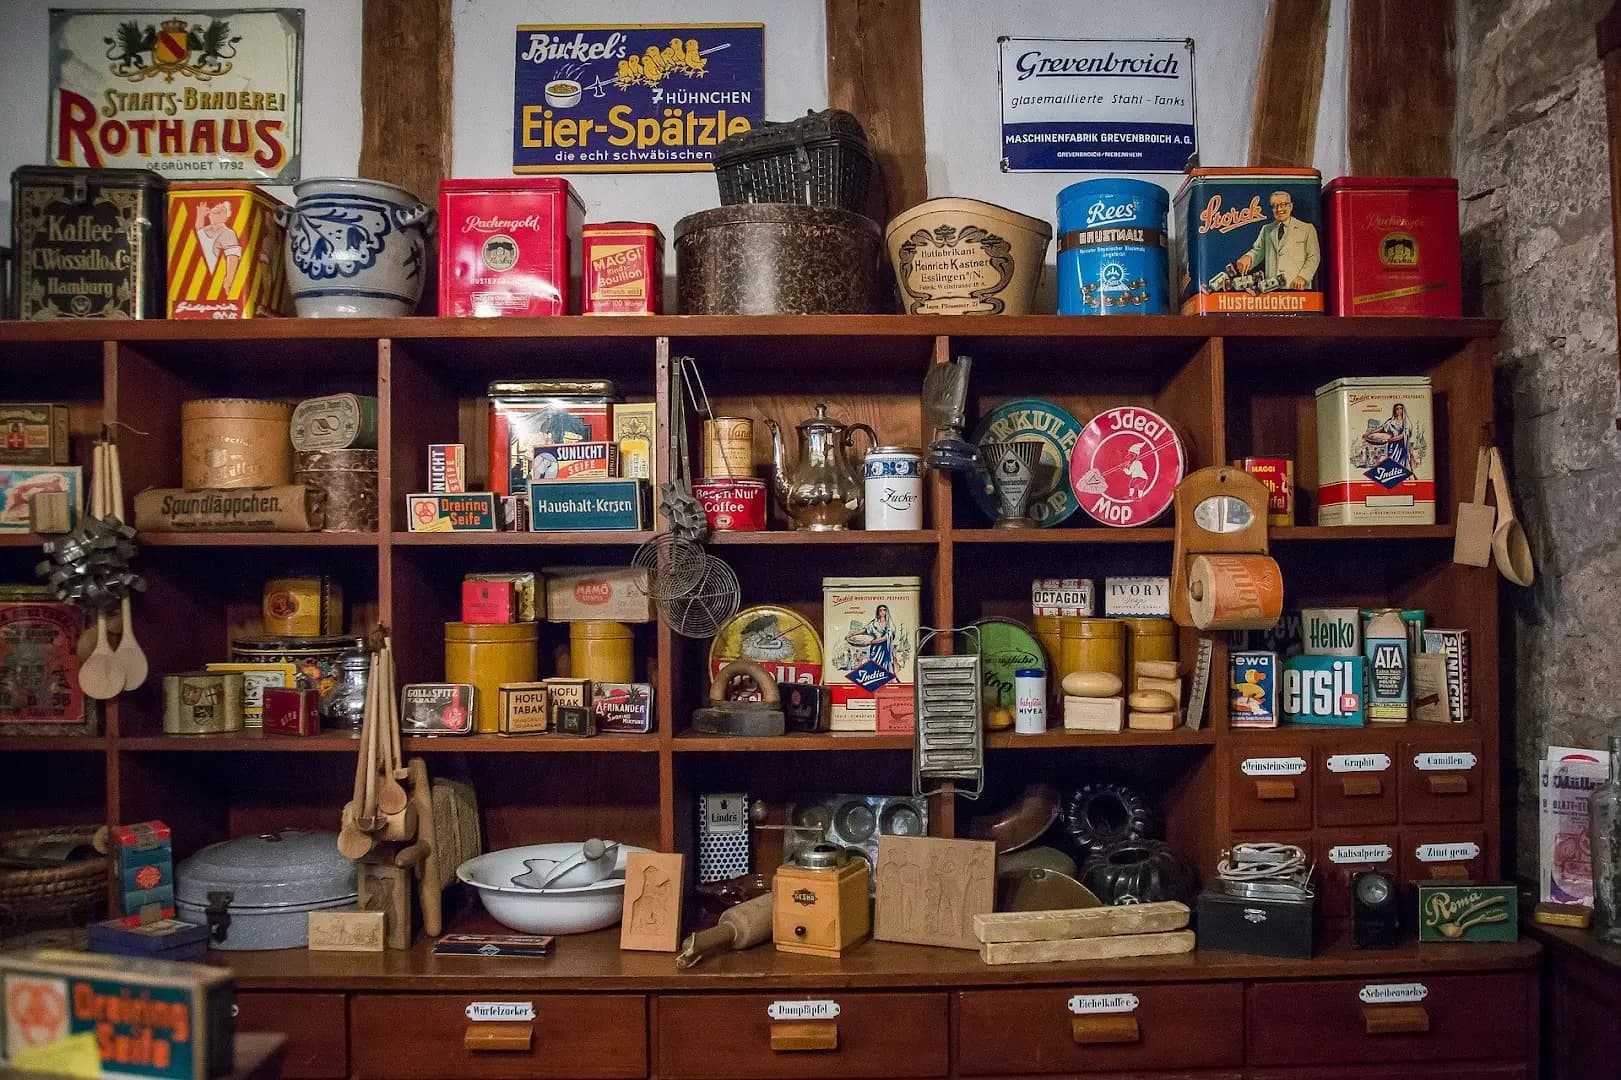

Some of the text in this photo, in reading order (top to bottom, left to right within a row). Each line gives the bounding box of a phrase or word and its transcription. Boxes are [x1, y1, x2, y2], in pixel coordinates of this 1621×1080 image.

[521, 32, 628, 64] Birkel's
[1016, 51, 1179, 81] Grevenbroich
[666, 89, 751, 104] HÜHNCHEN
[58, 88, 287, 171] ROTHAUS
[522, 105, 751, 148] Eier-Spätzle
[1006, 133, 1098, 145] MASCHINENFABRIK
[1101, 134, 1172, 144] GREVENBROICH
[555, 149, 713, 162] die echt schwäbischen
[219, 161, 245, 171] 1792
[1086, 200, 1136, 224] Rees
[1199, 194, 1268, 234] Storck
[48, 215, 114, 242] Kaffee
[461, 215, 540, 233] Rachengold
[915, 261, 949, 272] Heinrich
[921, 273, 966, 283] Esslingen
[48, 278, 113, 298] Hamburg
[1218, 294, 1307, 310] Hustendoktor
[556, 446, 603, 462] SUNLICHT
[431, 449, 446, 493] NLICHT
[567, 461, 596, 474] SEIFE
[1374, 468, 1404, 480] India
[446, 460, 460, 491] SEIFE
[160, 494, 284, 519] Spundläppchen.
[538, 498, 633, 514] Haushalt-Kerzen
[880, 487, 917, 511] Zucker
[441, 499, 488, 517] Dreiring
[704, 502, 745, 513] Coffee
[1090, 497, 1133, 524] Mop
[450, 512, 481, 526] Seife
[1111, 583, 1164, 597] IVORY
[1034, 591, 1087, 605] OCTAGON
[1310, 617, 1355, 649] Henko
[1374, 646, 1404, 669] ATA
[856, 669, 887, 684] India
[1444, 634, 1461, 720] SUNLICHT
[550, 687, 579, 697] HOFU
[1283, 660, 1353, 717] ersil
[515, 693, 544, 704] HOFU
[552, 699, 580, 708] ABAK
[513, 705, 545, 715] TABAK
[1344, 758, 1374, 769] Graphit
[1427, 756, 1463, 766] Camillen
[1426, 847, 1448, 857] Zimt
[1365, 987, 1422, 999] Scheibenwachs
[473, 1005, 529, 1016] Würfelzucker
[778, 1004, 828, 1017] Dampfäpfel
[1078, 998, 1132, 1009] Eichelkaffee
